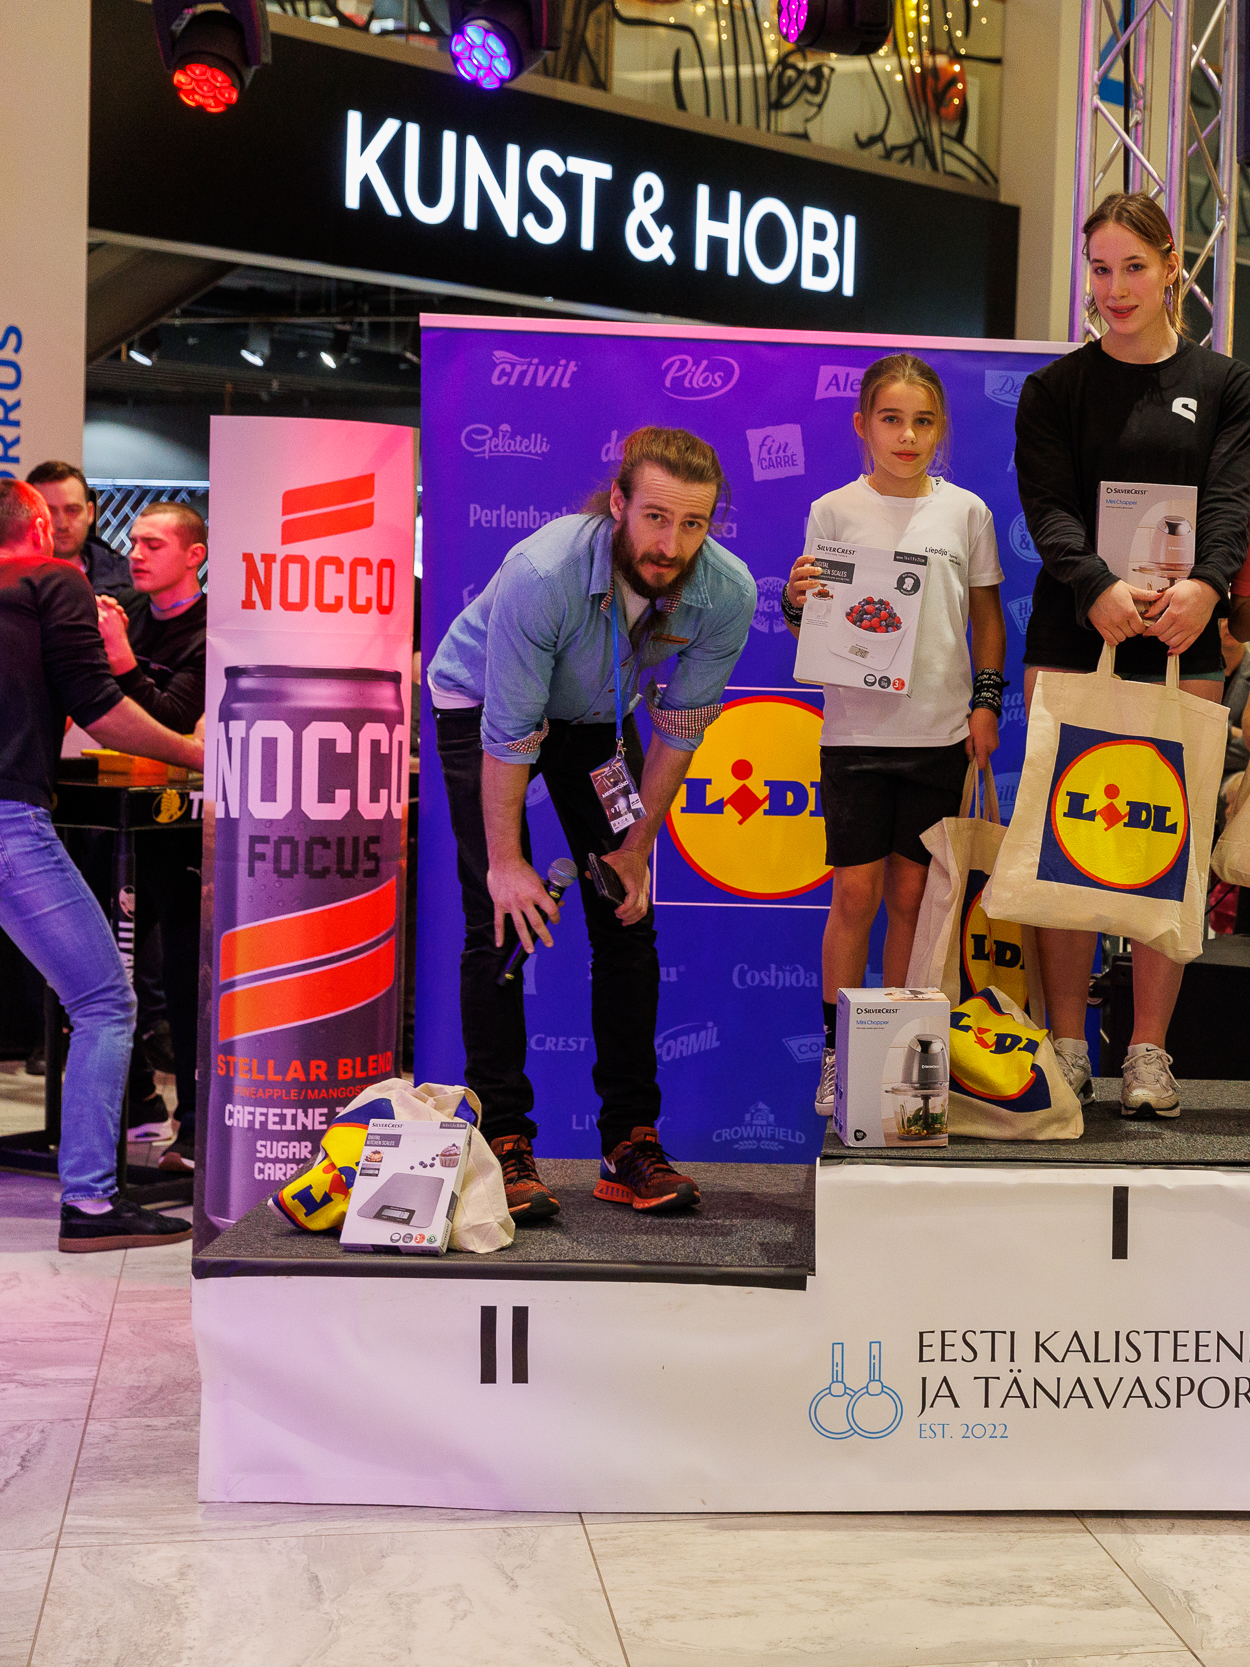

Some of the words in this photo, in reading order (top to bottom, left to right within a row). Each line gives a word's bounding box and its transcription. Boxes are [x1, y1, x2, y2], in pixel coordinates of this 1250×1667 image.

[344, 110, 612, 251] KUNST
[625, 171, 677, 265] &
[694, 184, 857, 297] HOBI
[491, 358, 578, 388] crivit
[663, 354, 724, 390] Pilos
[825, 372, 862, 392] Ale
[0, 325, 22, 480] RRUS
[461, 424, 550, 458] Gelatelli
[758, 435, 788, 466] fin
[760, 452, 798, 470] CARRÉ
[469, 504, 571, 529] Perlenbac
[241, 552, 395, 615] NOCCO
[214, 720, 405, 821] NOCCO
[1062, 783, 1178, 834] LIDL
[248, 835, 380, 879] FOCUS
[732, 964, 818, 989] Coshida
[529, 1034, 589, 1051] CREST
[217, 1054, 328, 1082] STELLAR
[338, 1051, 392, 1080] BLEND
[225, 1104, 328, 1130] CAFFEINE
[256, 1140, 312, 1159] SUGAR
[712, 1126, 805, 1144] CROWNFIELD
[917, 1330, 1016, 1363] EESTI
[917, 1376, 959, 1418] JA
[918, 1423, 954, 1439] EST.
[961, 1423, 1008, 1439] 2022
